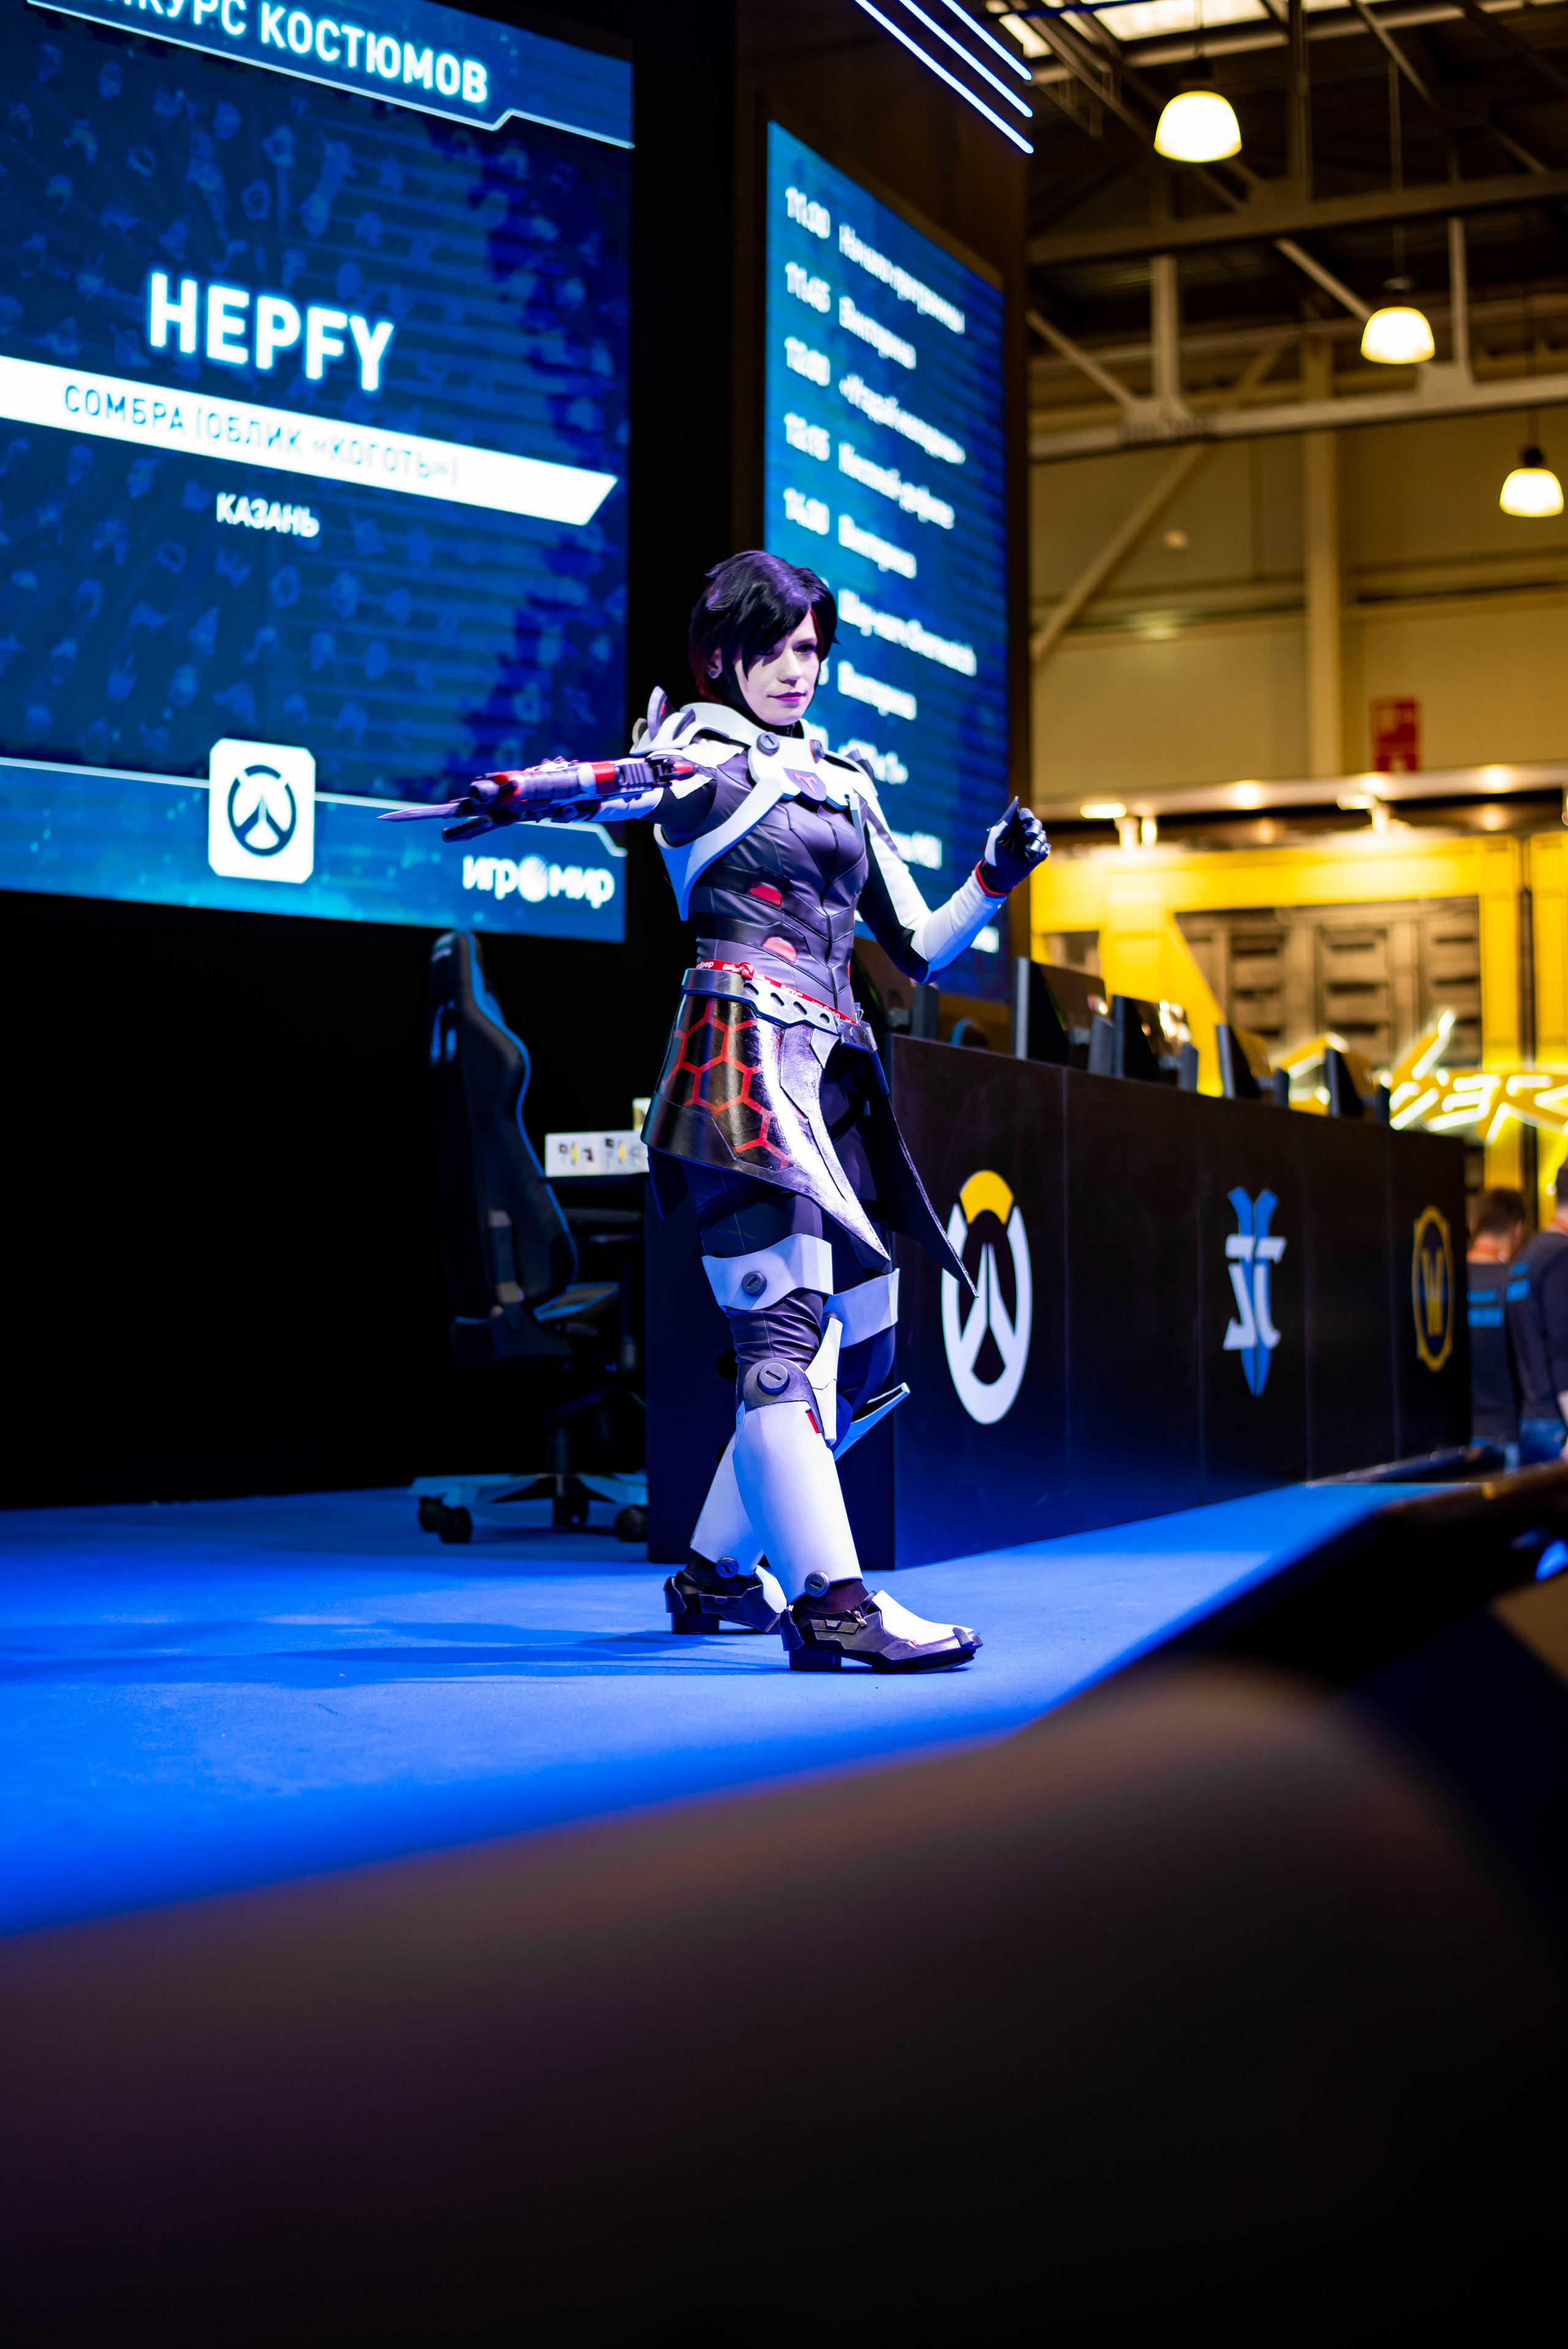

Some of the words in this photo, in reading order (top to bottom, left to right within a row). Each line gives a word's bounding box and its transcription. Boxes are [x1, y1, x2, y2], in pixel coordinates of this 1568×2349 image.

[260, 2, 489, 104] КОСТЮМОВ
[150, 273, 394, 392] HEPFY
[65, 385, 184, 434] СОМБРА
[216, 492, 320, 538] КАЗАНЬ
